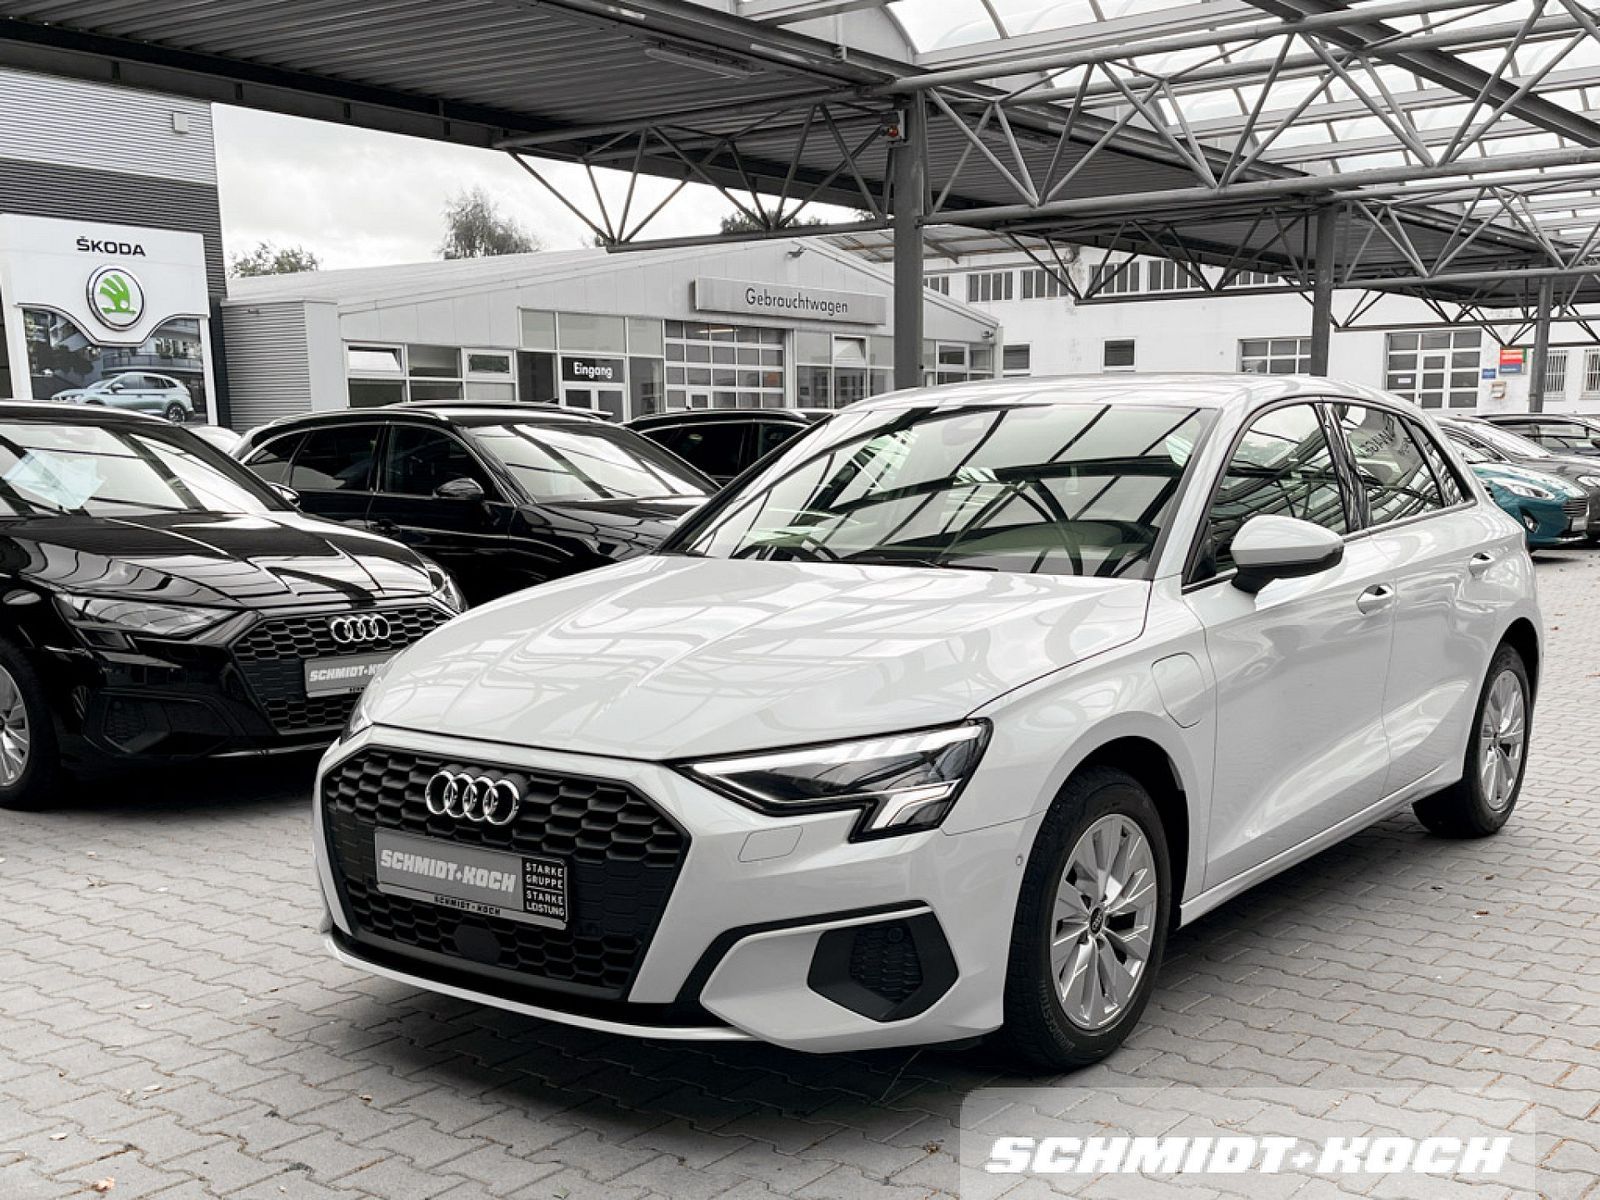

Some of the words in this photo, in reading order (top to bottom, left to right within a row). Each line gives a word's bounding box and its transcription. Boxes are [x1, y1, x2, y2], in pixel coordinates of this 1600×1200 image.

[76, 235, 146, 257] ŠKODA
[745, 288, 848, 316] Gebrauchtwagen
[573, 361, 613, 379] Eingang
[526, 862, 563, 877] STARKE
[526, 874, 563, 889] GRUPPE
[526, 890, 563, 905] STARKE
